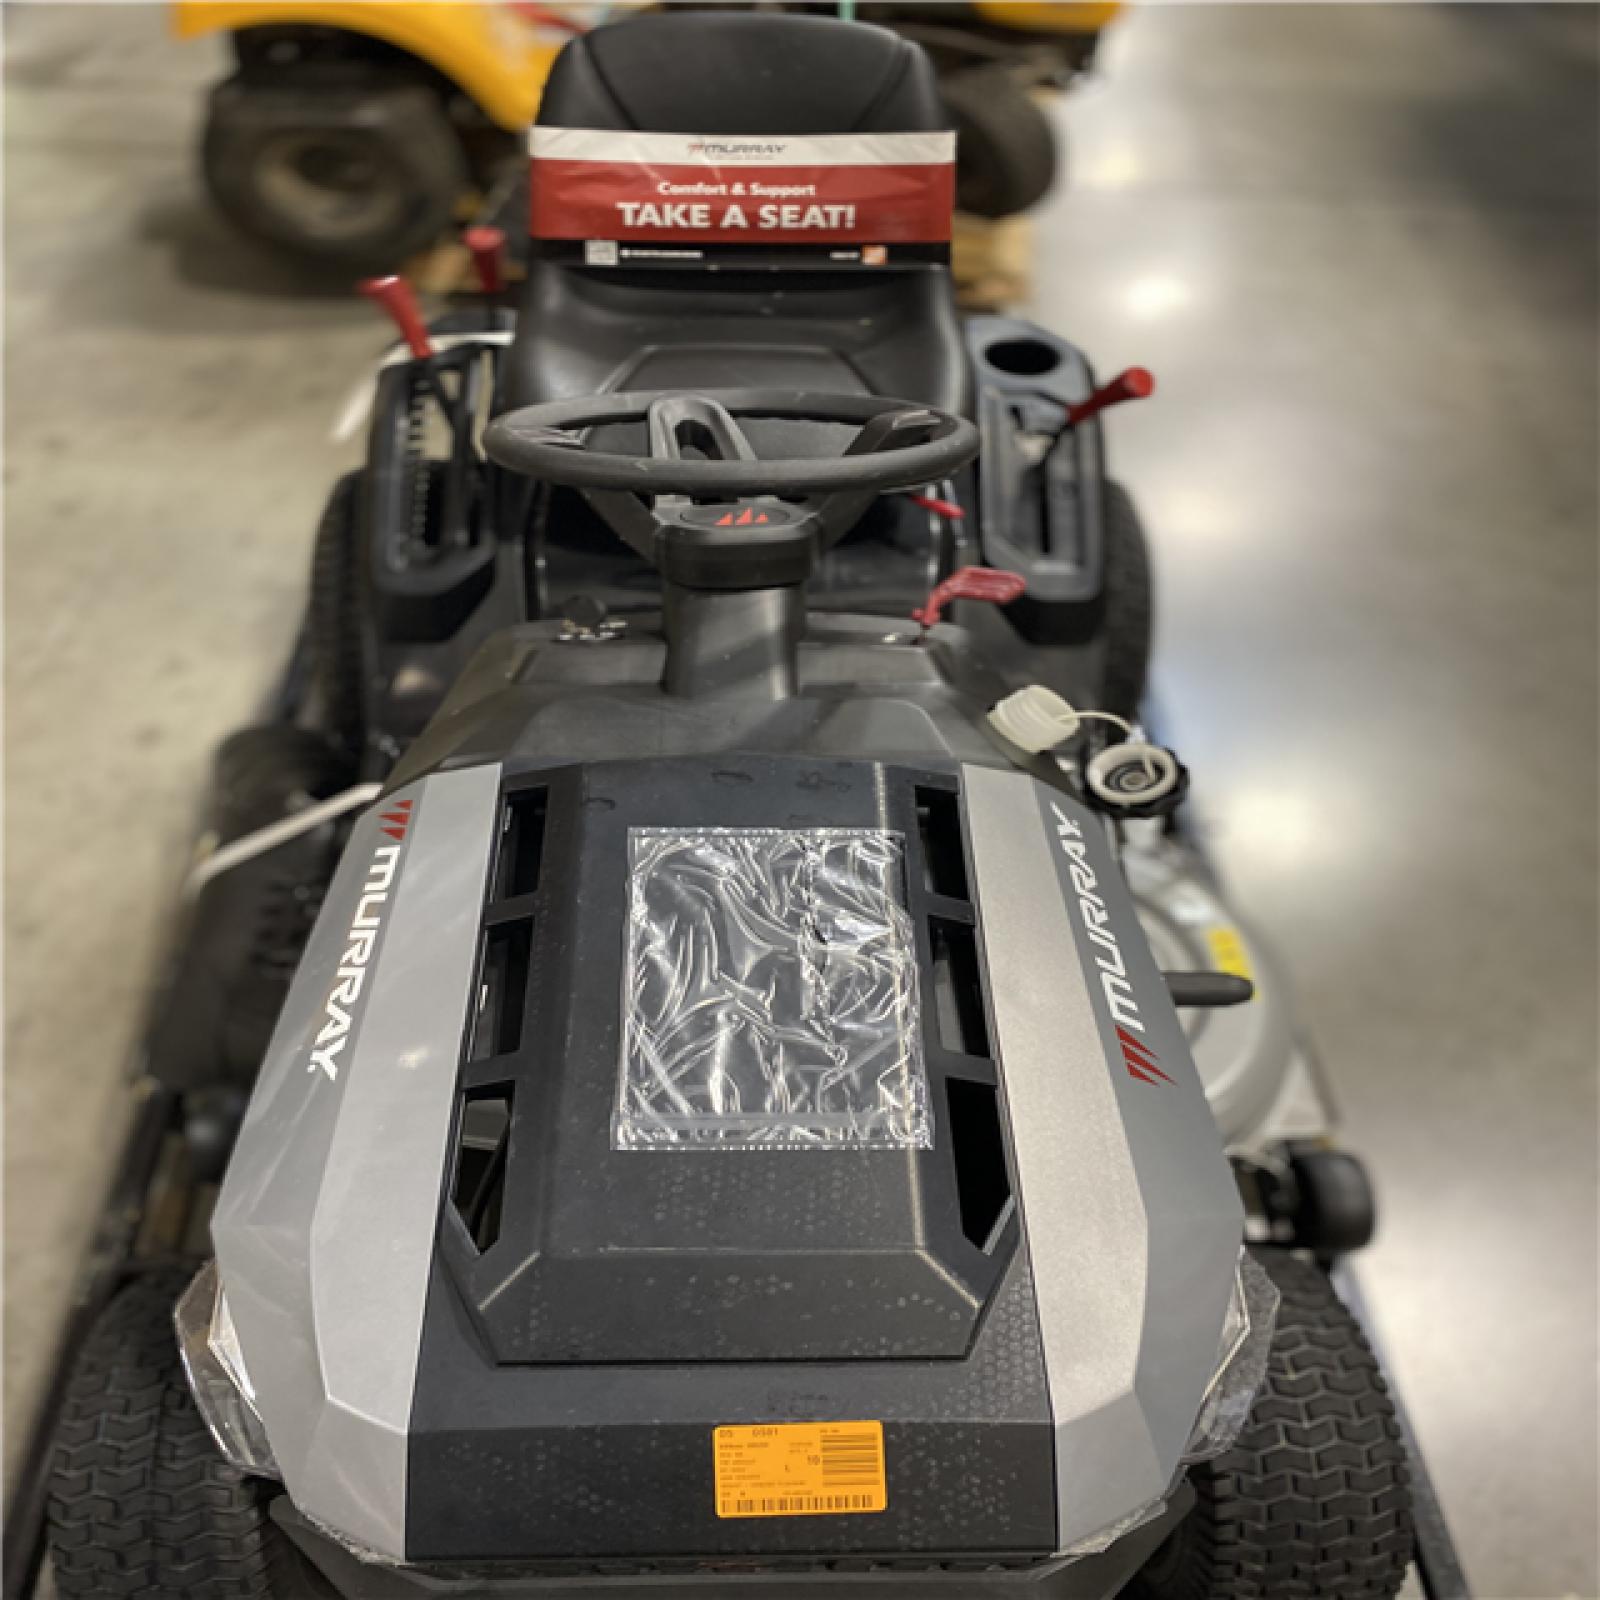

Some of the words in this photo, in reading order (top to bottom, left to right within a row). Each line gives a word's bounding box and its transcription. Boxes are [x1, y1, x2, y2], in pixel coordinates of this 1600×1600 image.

[616, 202, 711, 228] TAKE
[719, 203, 748, 228] A
[757, 203, 855, 229] SEAT!
[657, 181, 727, 196] Comfort
[729, 182, 746, 196] &
[750, 182, 816, 199] Support
[307, 844, 401, 1080] MURRAY
[1050, 801, 1145, 1032] MURRAY
